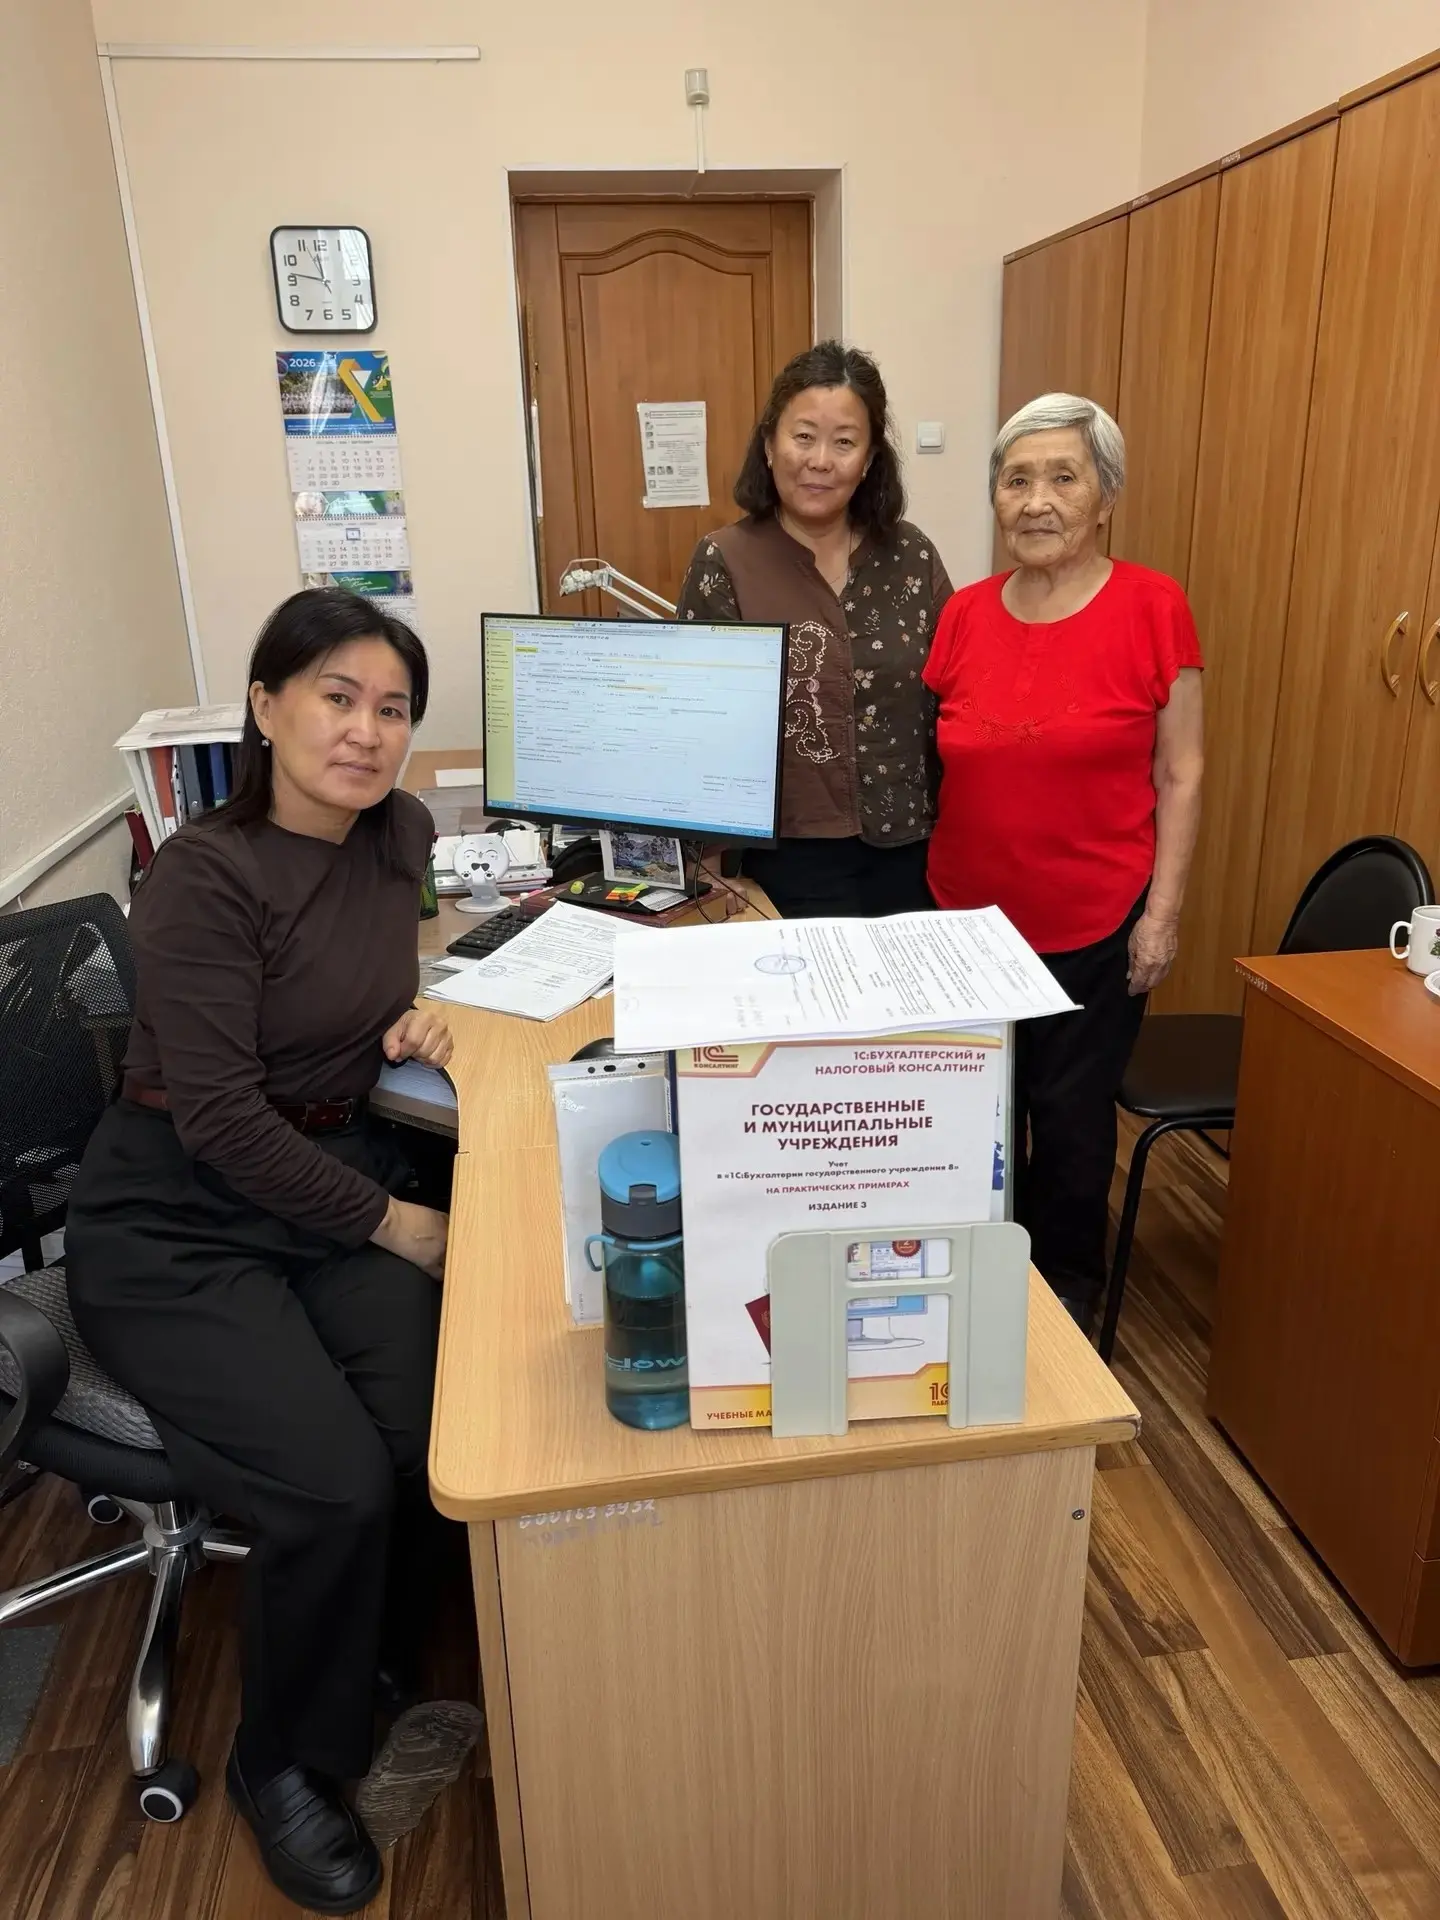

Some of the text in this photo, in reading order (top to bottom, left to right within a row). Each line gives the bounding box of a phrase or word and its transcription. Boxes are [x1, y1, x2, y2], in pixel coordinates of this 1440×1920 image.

[298, 239, 341, 252] 11 12 1
[283, 254, 298, 267] 10
[287, 274, 361, 287] 9 3
[289, 293, 364, 307] 8 4
[305, 308, 352, 321] 7 6 5
[289, 358, 316, 368] 2026
[854, 1050, 986, 1060] 1С:БУХГАЛТЕРСКИЙ И
[815, 1062, 985, 1075] НАЛОГОВЫЙ КОНСАЛТИНГ
[751, 1099, 925, 1117] ГОСУДАРСТВЕННЫЕ
[744, 1116, 933, 1134] И МУНИЦИПАЛЬНЫЕ
[777, 1135, 898, 1150] УЧРЕЖДЕНИЯ
[805, 1168, 886, 1177] государственного
[889, 1165, 946, 1174] учреждения
[782, 1183, 856, 1193] ПРАКТИЧЕСКИХ
[858, 1181, 910, 1190] ПРИМЕРАХ
[808, 1202, 858, 1211] ИЗДАНИЕ
[706, 1410, 753, 1420] УЧЕБНЫЕ
